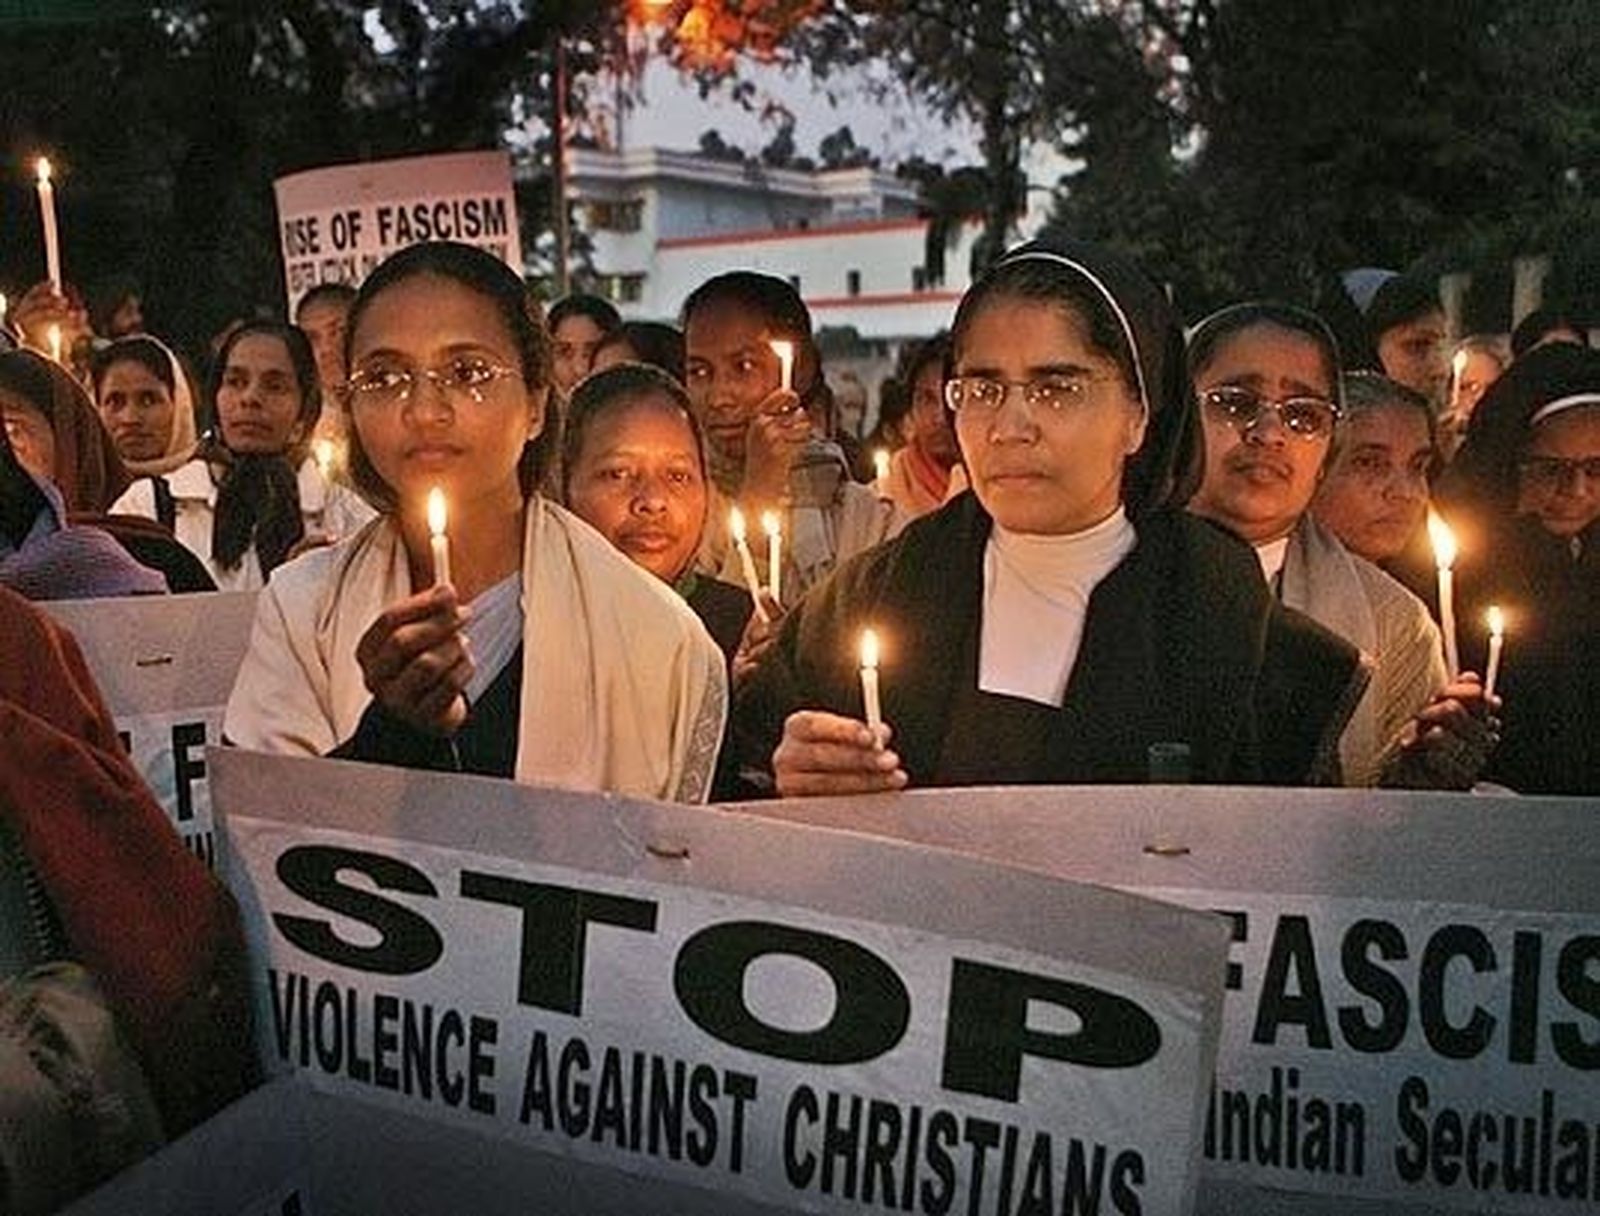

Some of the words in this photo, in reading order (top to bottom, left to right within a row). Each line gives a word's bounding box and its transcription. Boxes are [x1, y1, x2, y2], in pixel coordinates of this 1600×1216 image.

[331, 210, 362, 250] OF
[376, 197, 508, 245] FASCISM
[272, 845, 1162, 1103] STOP
[268, 968, 498, 1116] VIOLENCE
[519, 1031, 758, 1174] AGAINST
[783, 1085, 1146, 1216] CHRISTIANS
[1394, 1075, 1600, 1202] Secula
